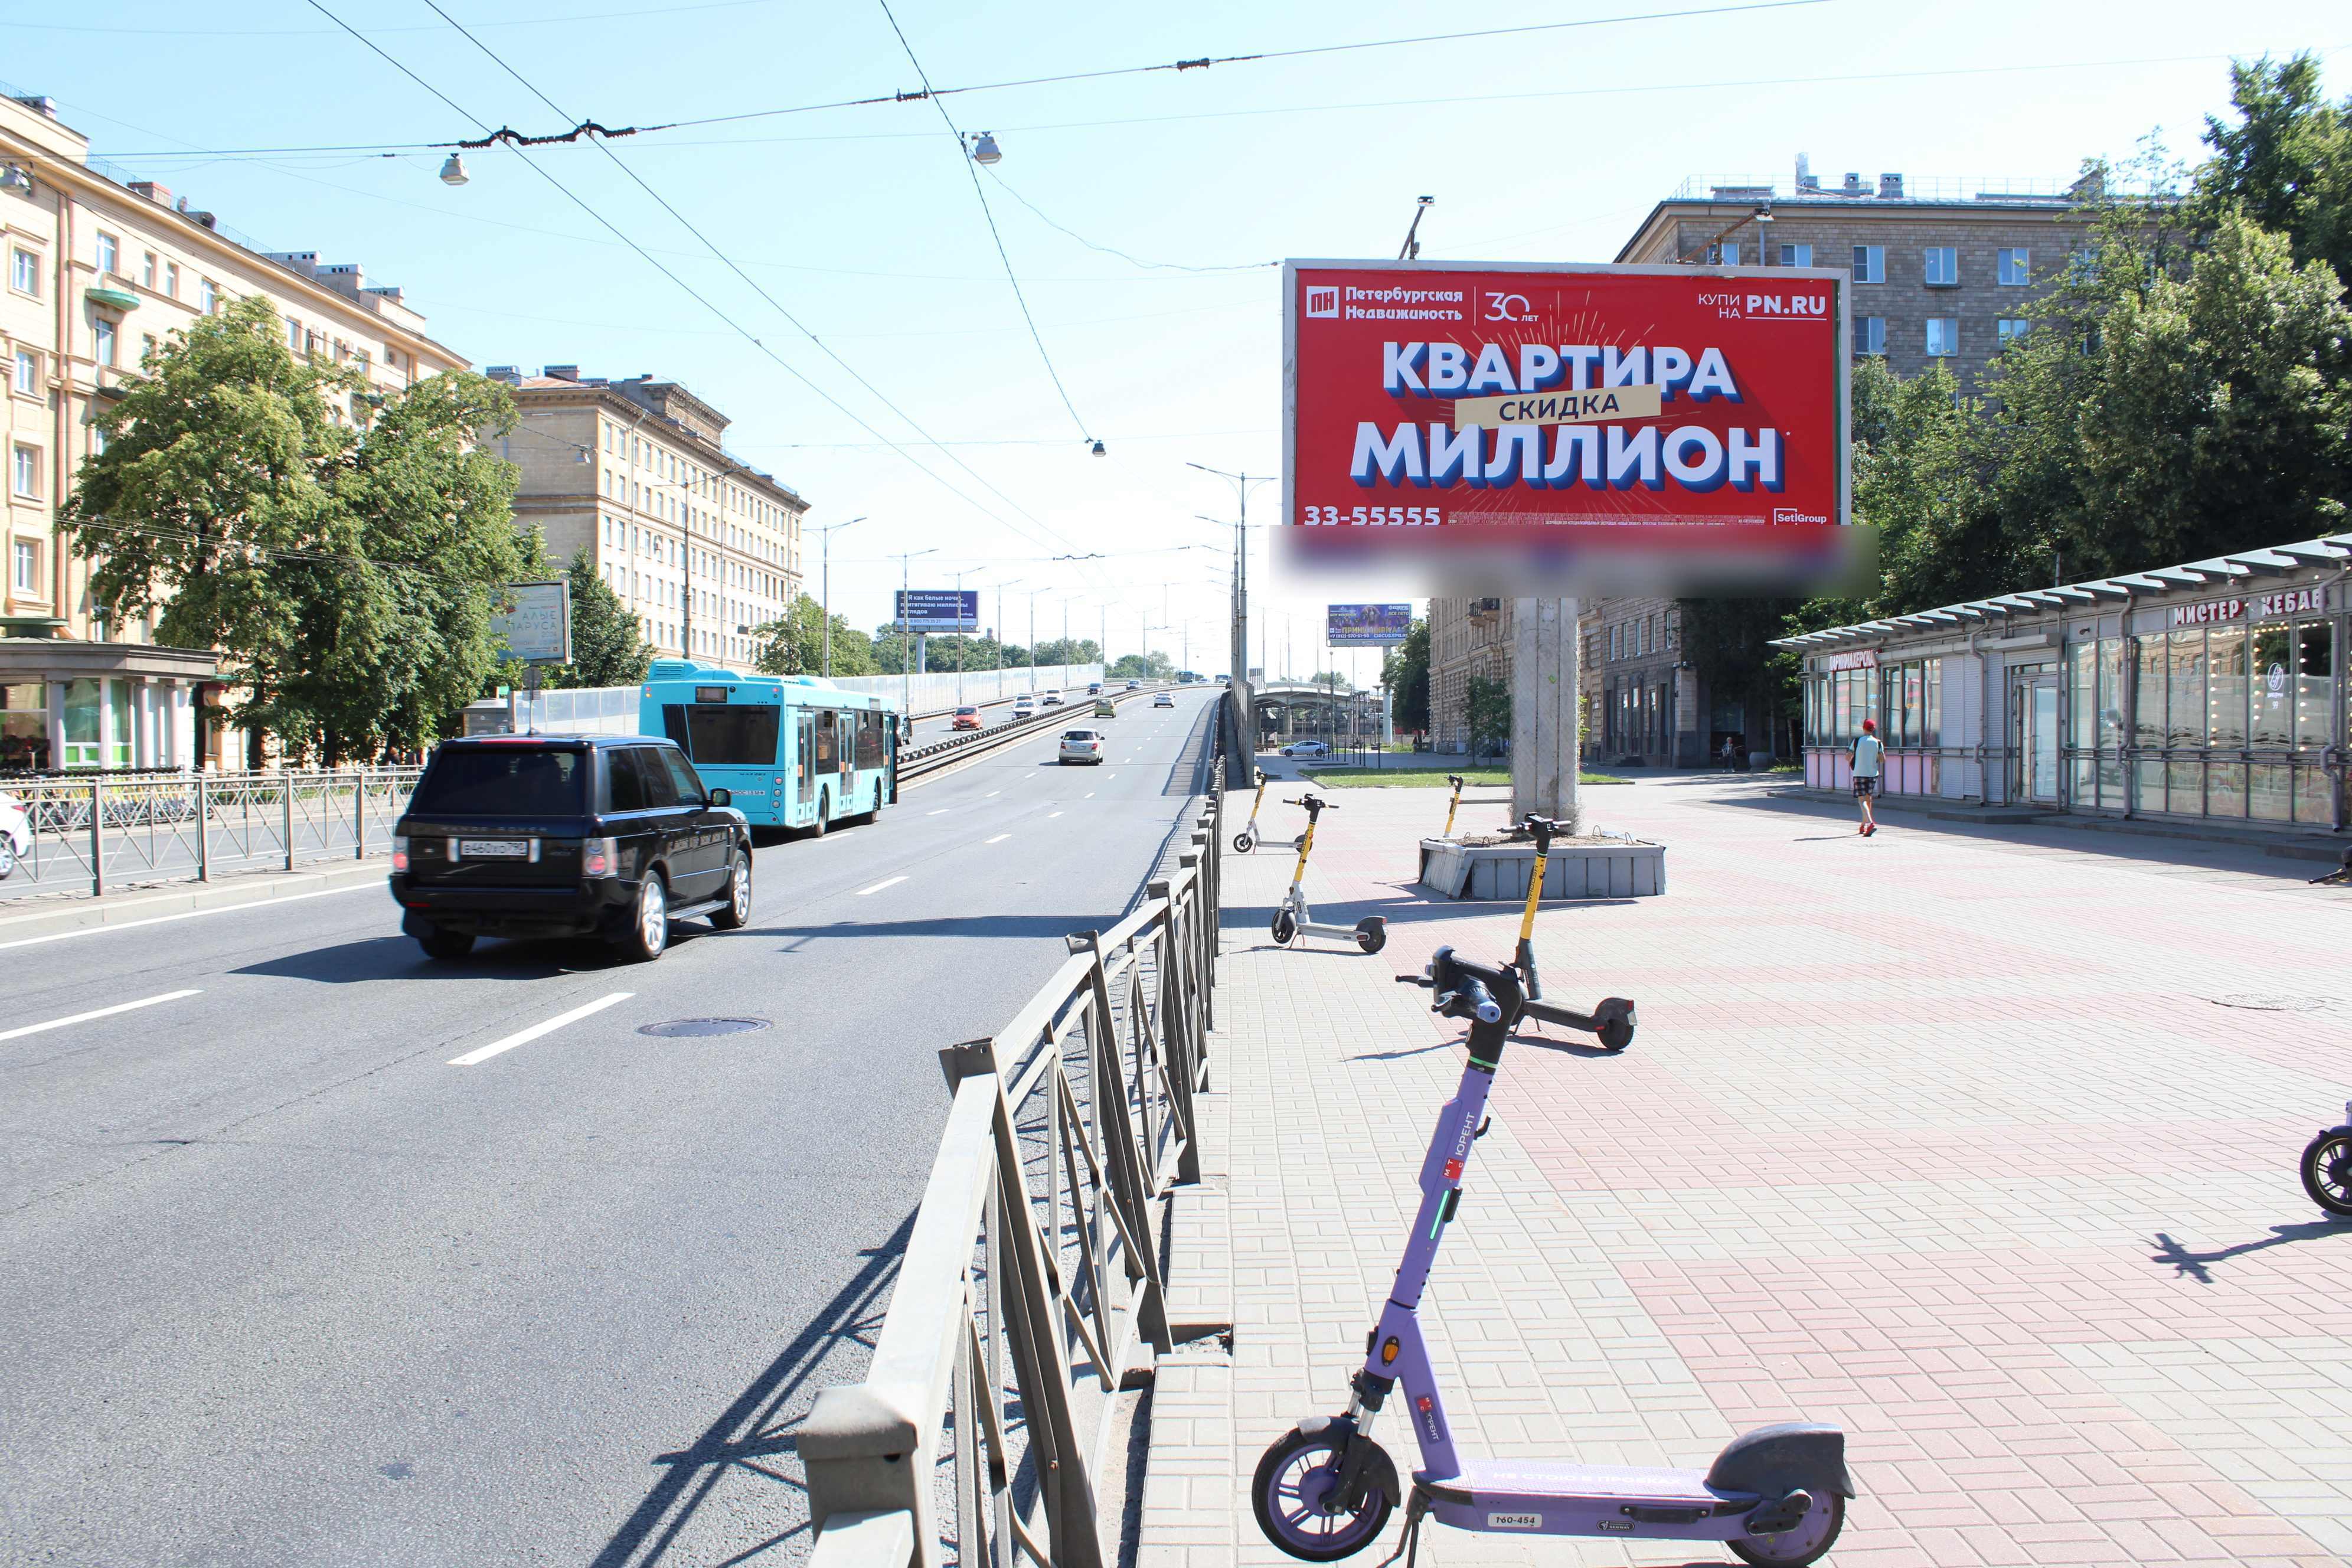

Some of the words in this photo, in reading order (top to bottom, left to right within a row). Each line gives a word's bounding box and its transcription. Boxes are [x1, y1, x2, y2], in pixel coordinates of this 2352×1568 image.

[1311, 290, 1335, 313] ПН
[1345, 286, 1463, 303] Петербургская
[1698, 293, 1740, 305] КУПИ
[1345, 305, 1463, 321] Недвижимость
[1484, 292, 1530, 322] 30
[1719, 307, 1741, 319] НА
[1747, 295, 1826, 315] PN.RU
[1383, 341, 1739, 398] КВАРТИРА
[1498, 393, 1620, 422] СКИДКА
[1304, 506, 1441, 525] 33-55555
[522, 610, 557, 620] АЛЫЕ
[2174, 599, 2239, 625] МИСТЕР
[509, 621, 557, 632] ПАРУСА
[1829, 649, 1877, 671] ПАРИКМАХЕРСКА
[1455, 1112, 1475, 1157] ЮРЕНТ
